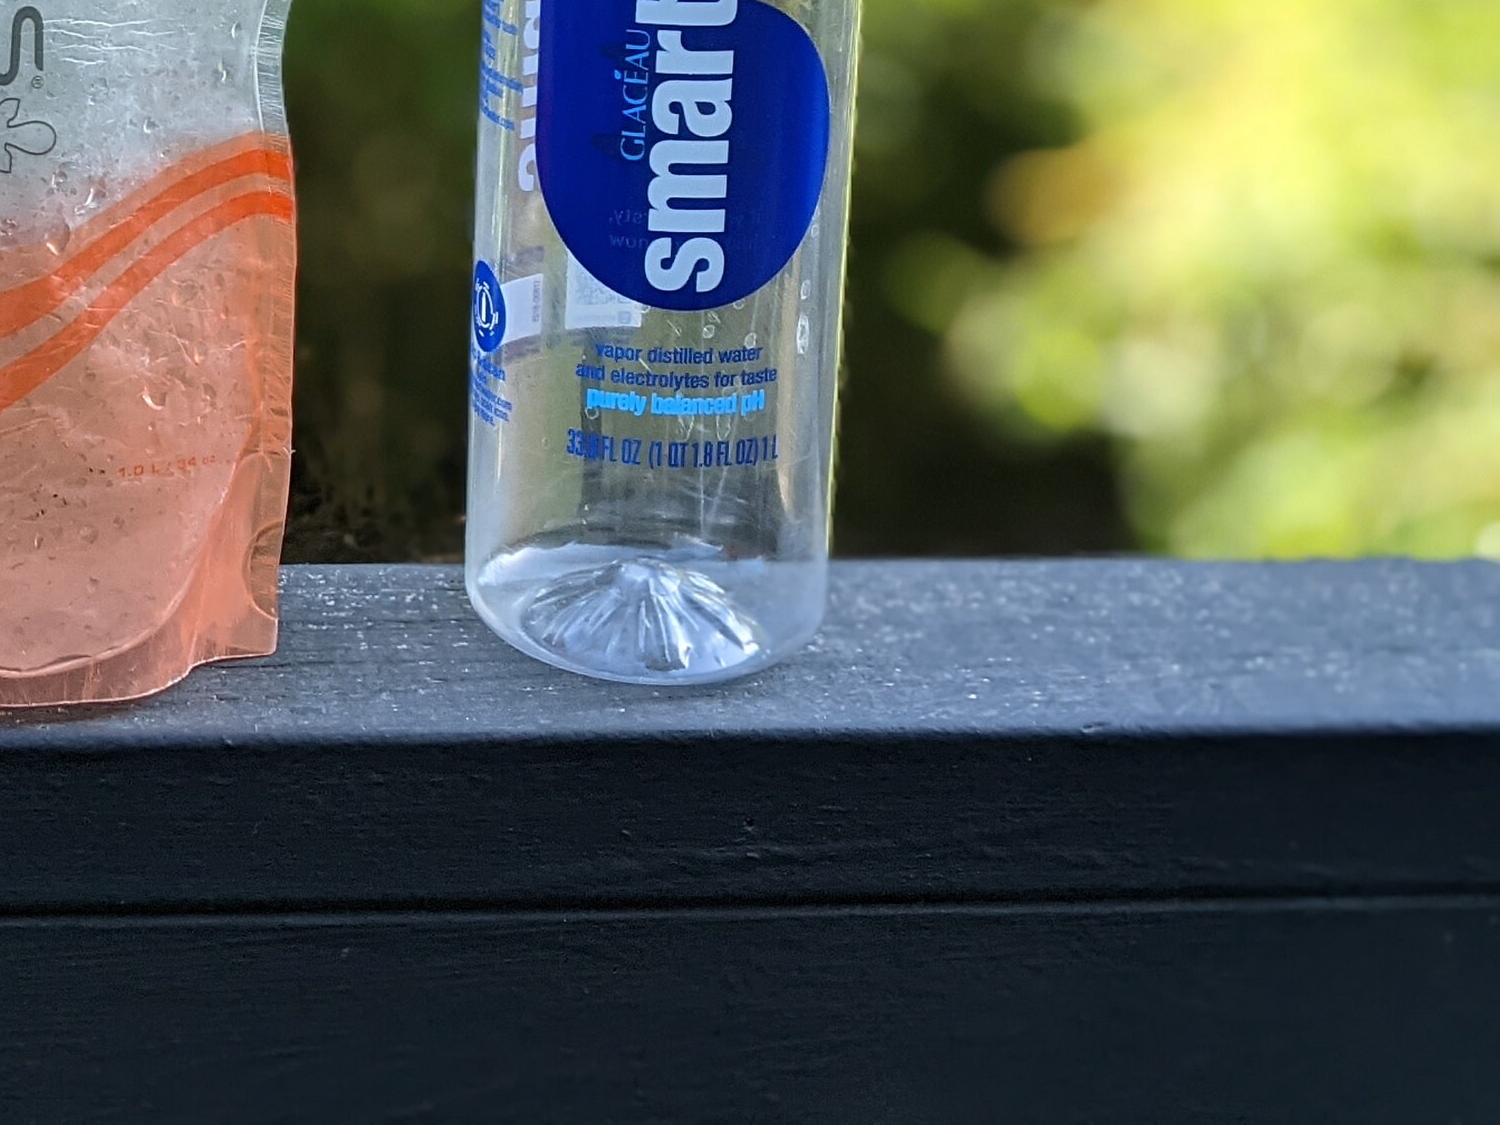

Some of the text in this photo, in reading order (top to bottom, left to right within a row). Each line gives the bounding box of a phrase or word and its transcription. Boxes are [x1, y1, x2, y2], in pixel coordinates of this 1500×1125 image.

[595, 342, 764, 365] vapor distilled water
[575, 363, 778, 392] and electrolytes for taste
[586, 387, 766, 417] purely balanced pH
[621, 438, 642, 465] OZ
[691, 441, 714, 468] 1.8
